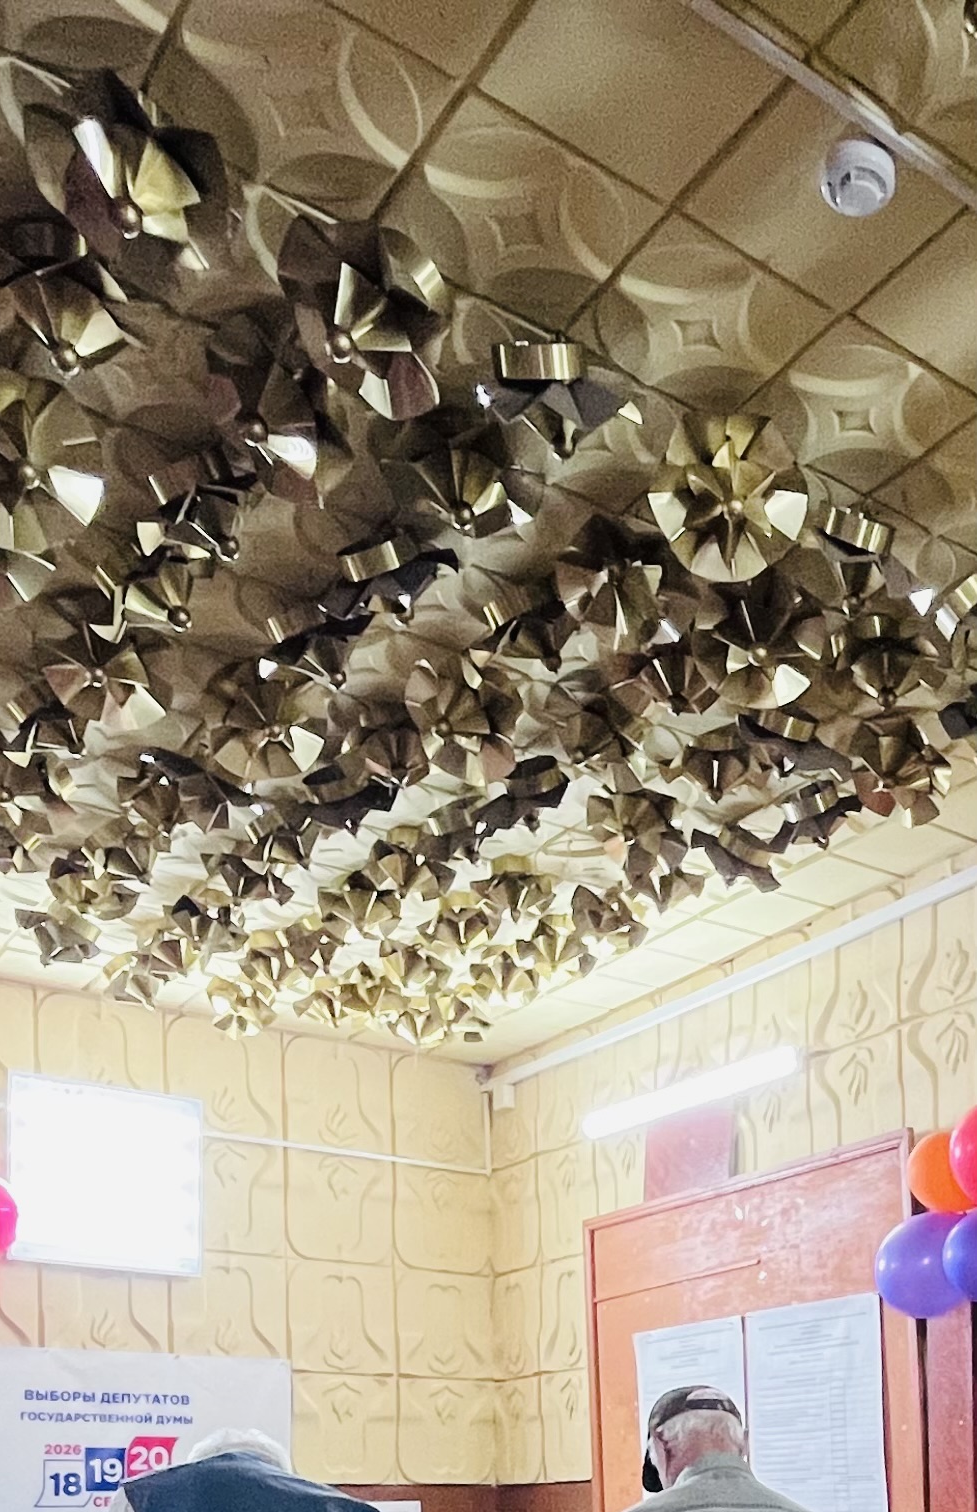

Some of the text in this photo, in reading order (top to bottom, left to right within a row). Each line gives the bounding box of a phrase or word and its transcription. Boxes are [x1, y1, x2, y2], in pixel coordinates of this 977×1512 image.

[24, 1389, 191, 1405] ВЫБОРЫ ДЕПУТАТОВ
[20, 1411, 194, 1425] ГОСУДАРСТВЕННОЙ ДУМЫ
[44, 1444, 82, 1456] 2026
[49, 1446, 170, 1497] 18 19 20
